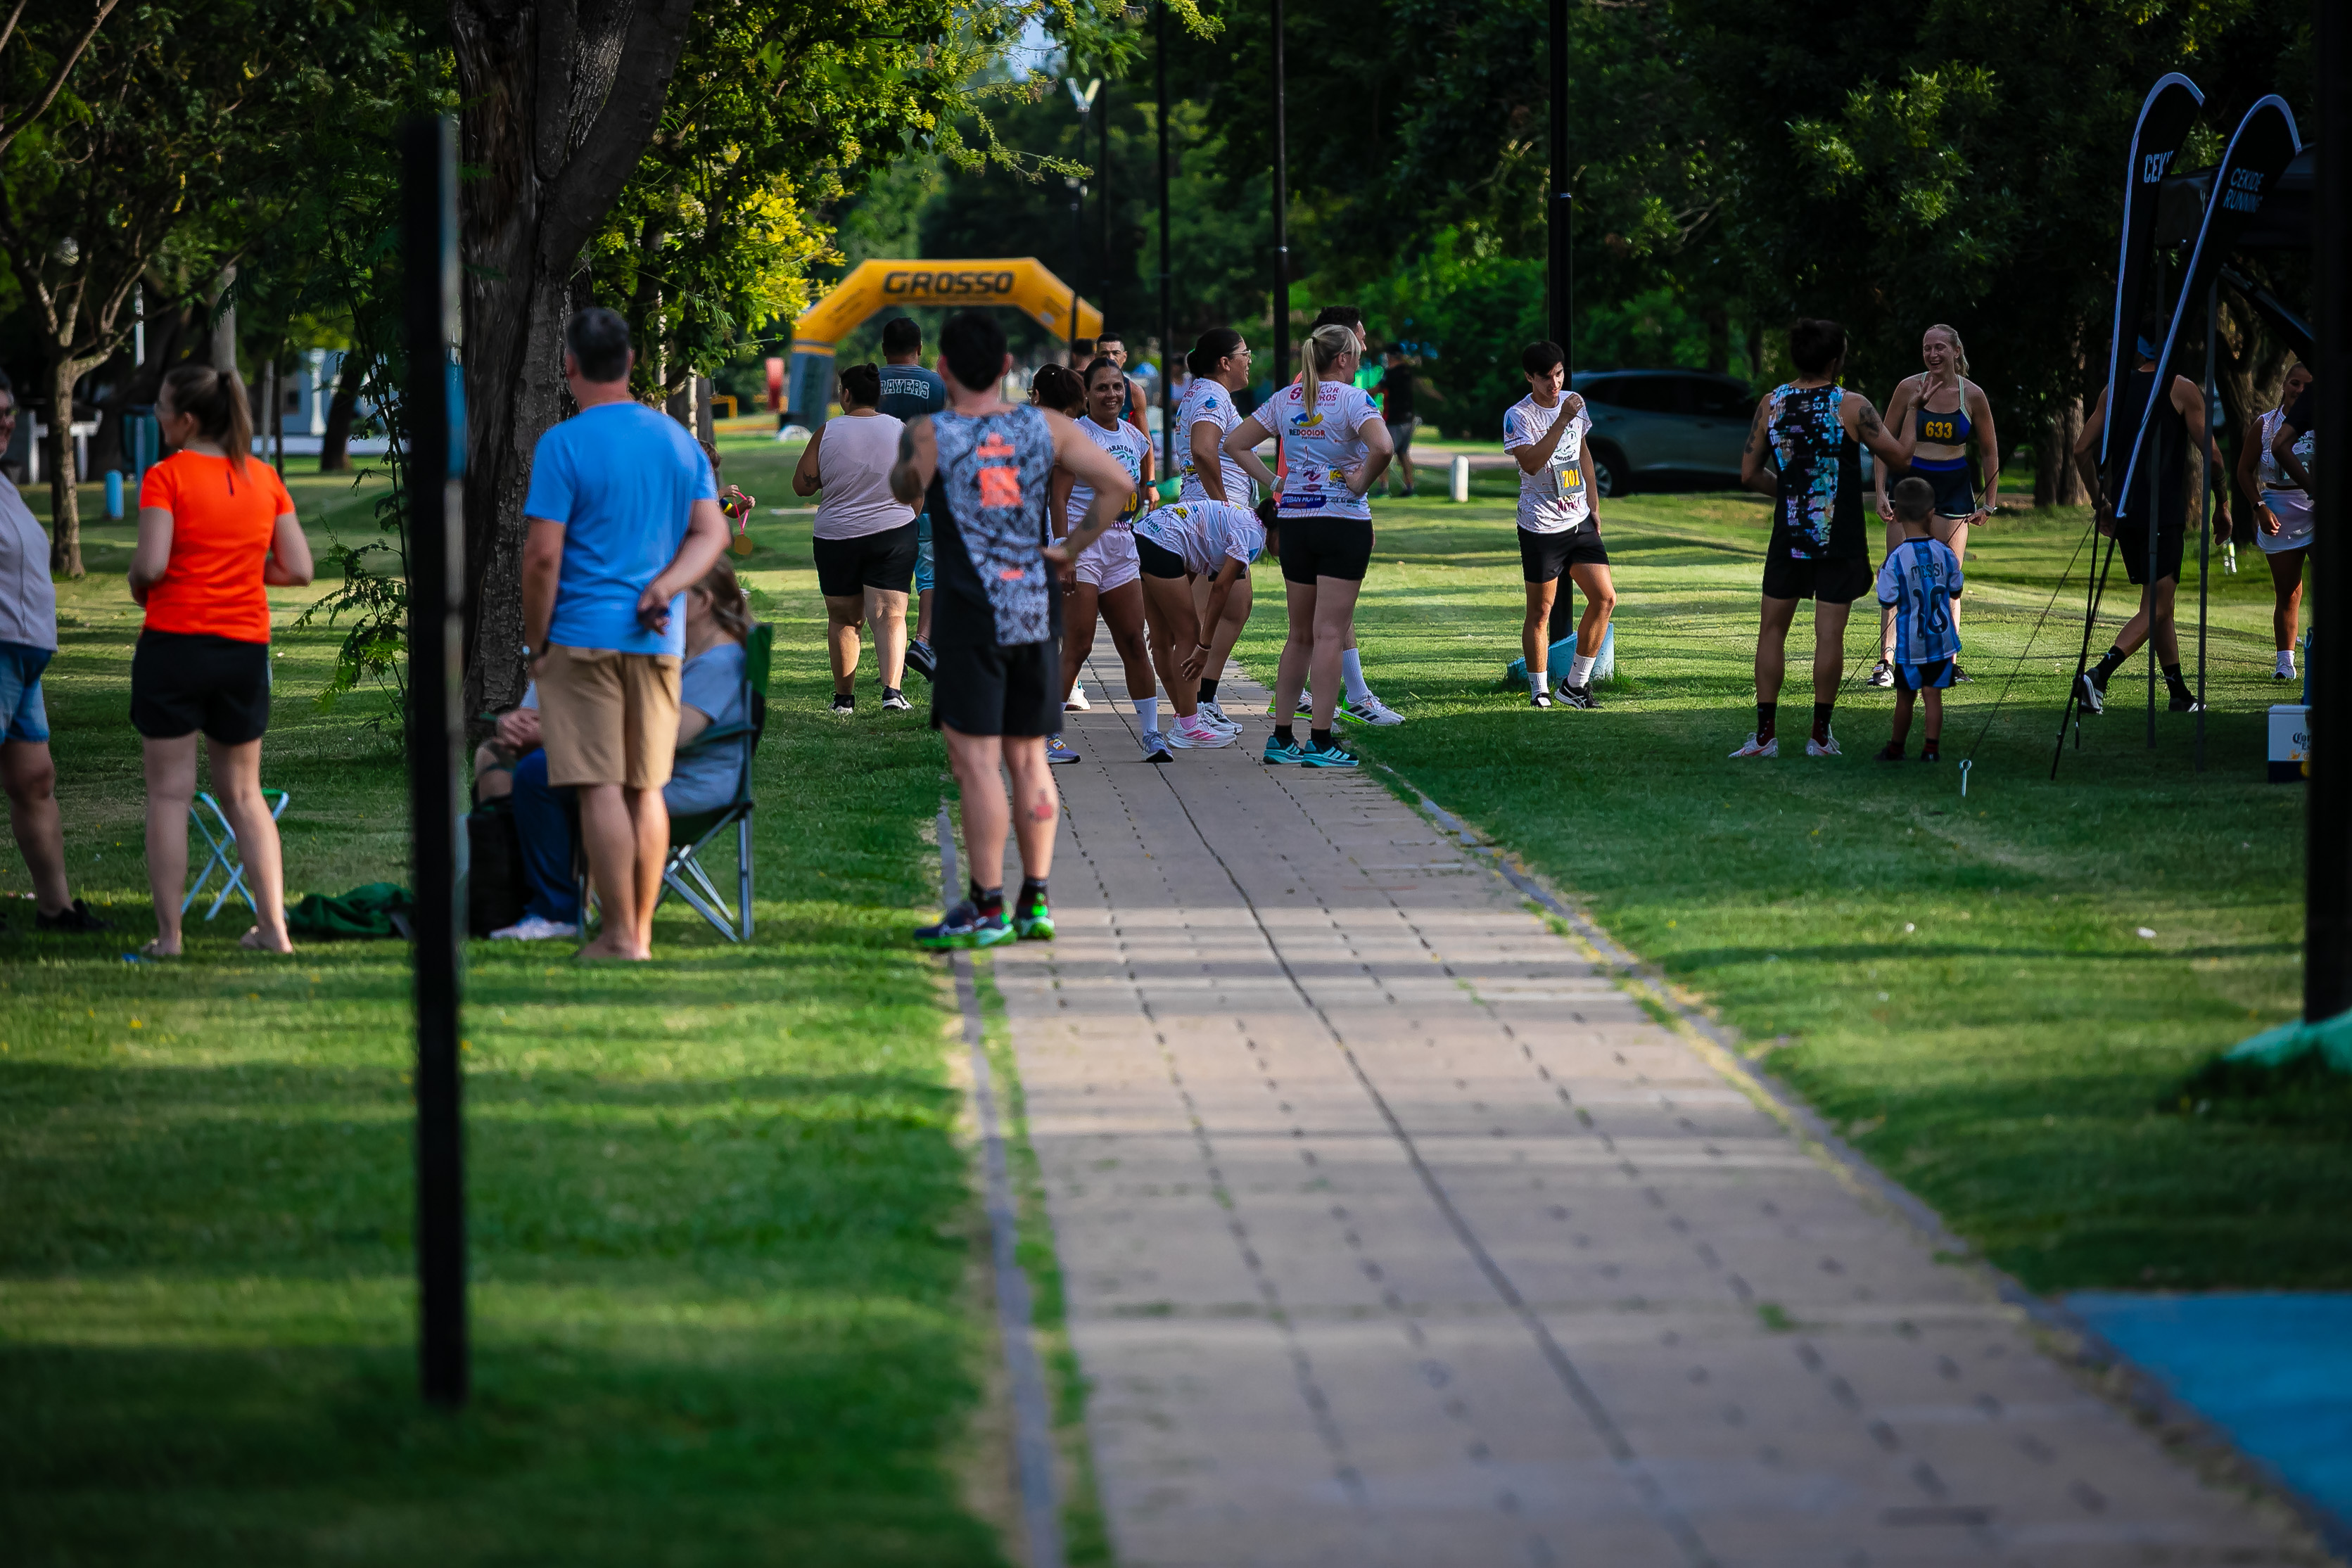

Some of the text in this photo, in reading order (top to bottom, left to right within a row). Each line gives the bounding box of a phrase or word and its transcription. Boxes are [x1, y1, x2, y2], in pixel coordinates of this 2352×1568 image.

[2144, 150, 2174, 183] CEK
[884, 271, 1014, 294] GROSSO
[880, 379, 929, 399] RAYERS
[1926, 421, 1952, 438] 633
[1562, 469, 1580, 487] 701
[1911, 562, 1944, 582] MESSI
